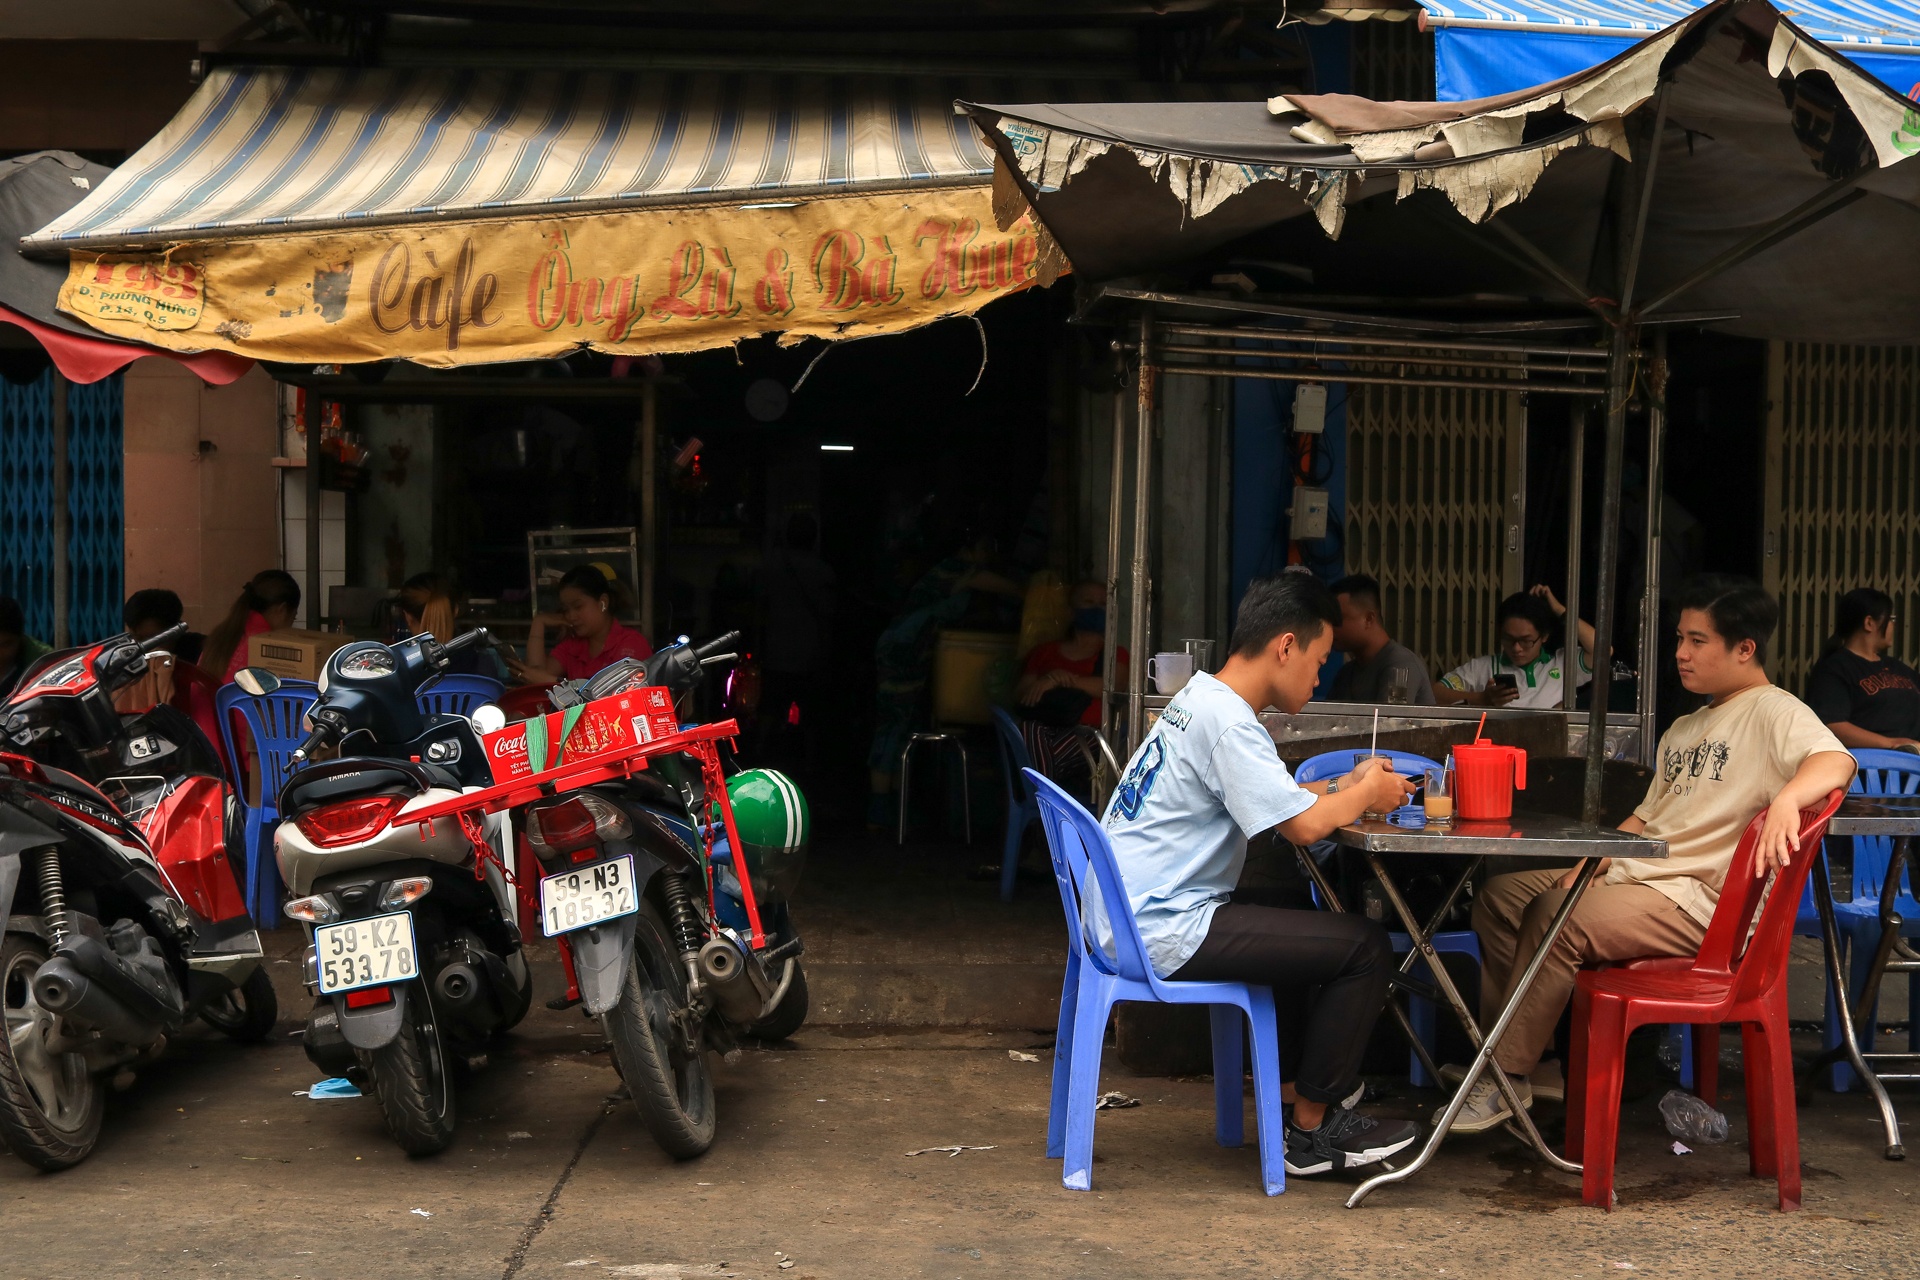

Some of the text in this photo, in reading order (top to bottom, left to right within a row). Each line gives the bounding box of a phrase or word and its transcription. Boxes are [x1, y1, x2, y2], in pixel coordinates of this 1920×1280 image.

[95, 264, 198, 300] 193
[527, 229, 645, 344] Ông
[650, 240, 742, 322] Lù
[754, 247, 796, 317] &
[809, 229, 904, 313] Bà
[143, 310, 167, 324] Q.5
[554, 863, 620, 902] 59-N3
[548, 887, 631, 931] 185.32
[330, 918, 400, 956] 59-K2
[324, 947, 412, 988] 533.78
